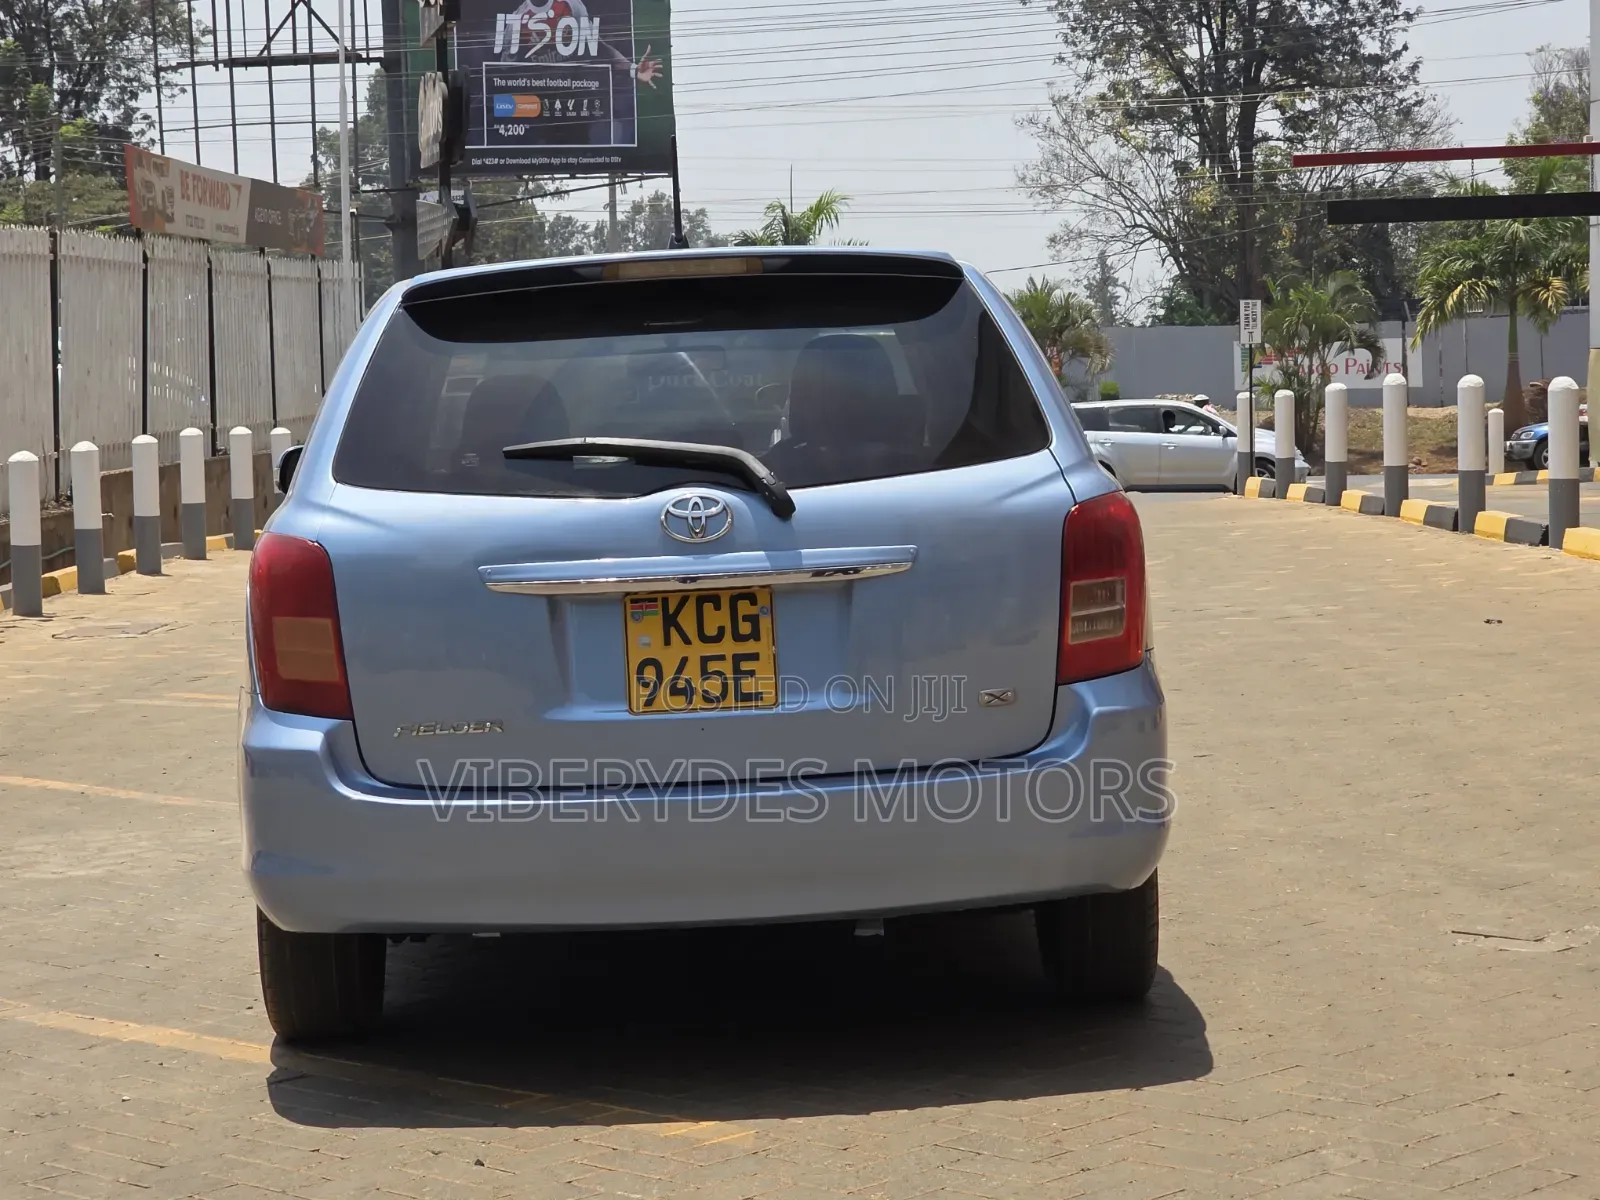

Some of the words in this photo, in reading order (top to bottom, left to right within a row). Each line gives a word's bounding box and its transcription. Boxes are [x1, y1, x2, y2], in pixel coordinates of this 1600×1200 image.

[555, 16, 600, 57] ON
[493, 78, 506, 87] The
[506, 78, 531, 88] world's
[531, 79, 546, 88] best
[546, 78, 571, 88] football
[571, 79, 599, 90] package
[498, 123, 525, 137] 4,200
[471, 157, 482, 165] Dial
[505, 156, 531, 165] Download
[550, 156, 561, 166] App
[561, 156, 567, 164] to
[567, 156, 578, 166] stay
[578, 155, 604, 164] Connected
[604, 155, 610, 163] to
[179, 168, 190, 202] BE
[192, 173, 231, 211] FORWARD
[1243, 301, 1251, 312] YOU
[1243, 313, 1251, 330] THANK
[660, 592, 762, 647] KCG
[636, 652, 764, 707] 945E
[392, 718, 504, 739] FIELDER
